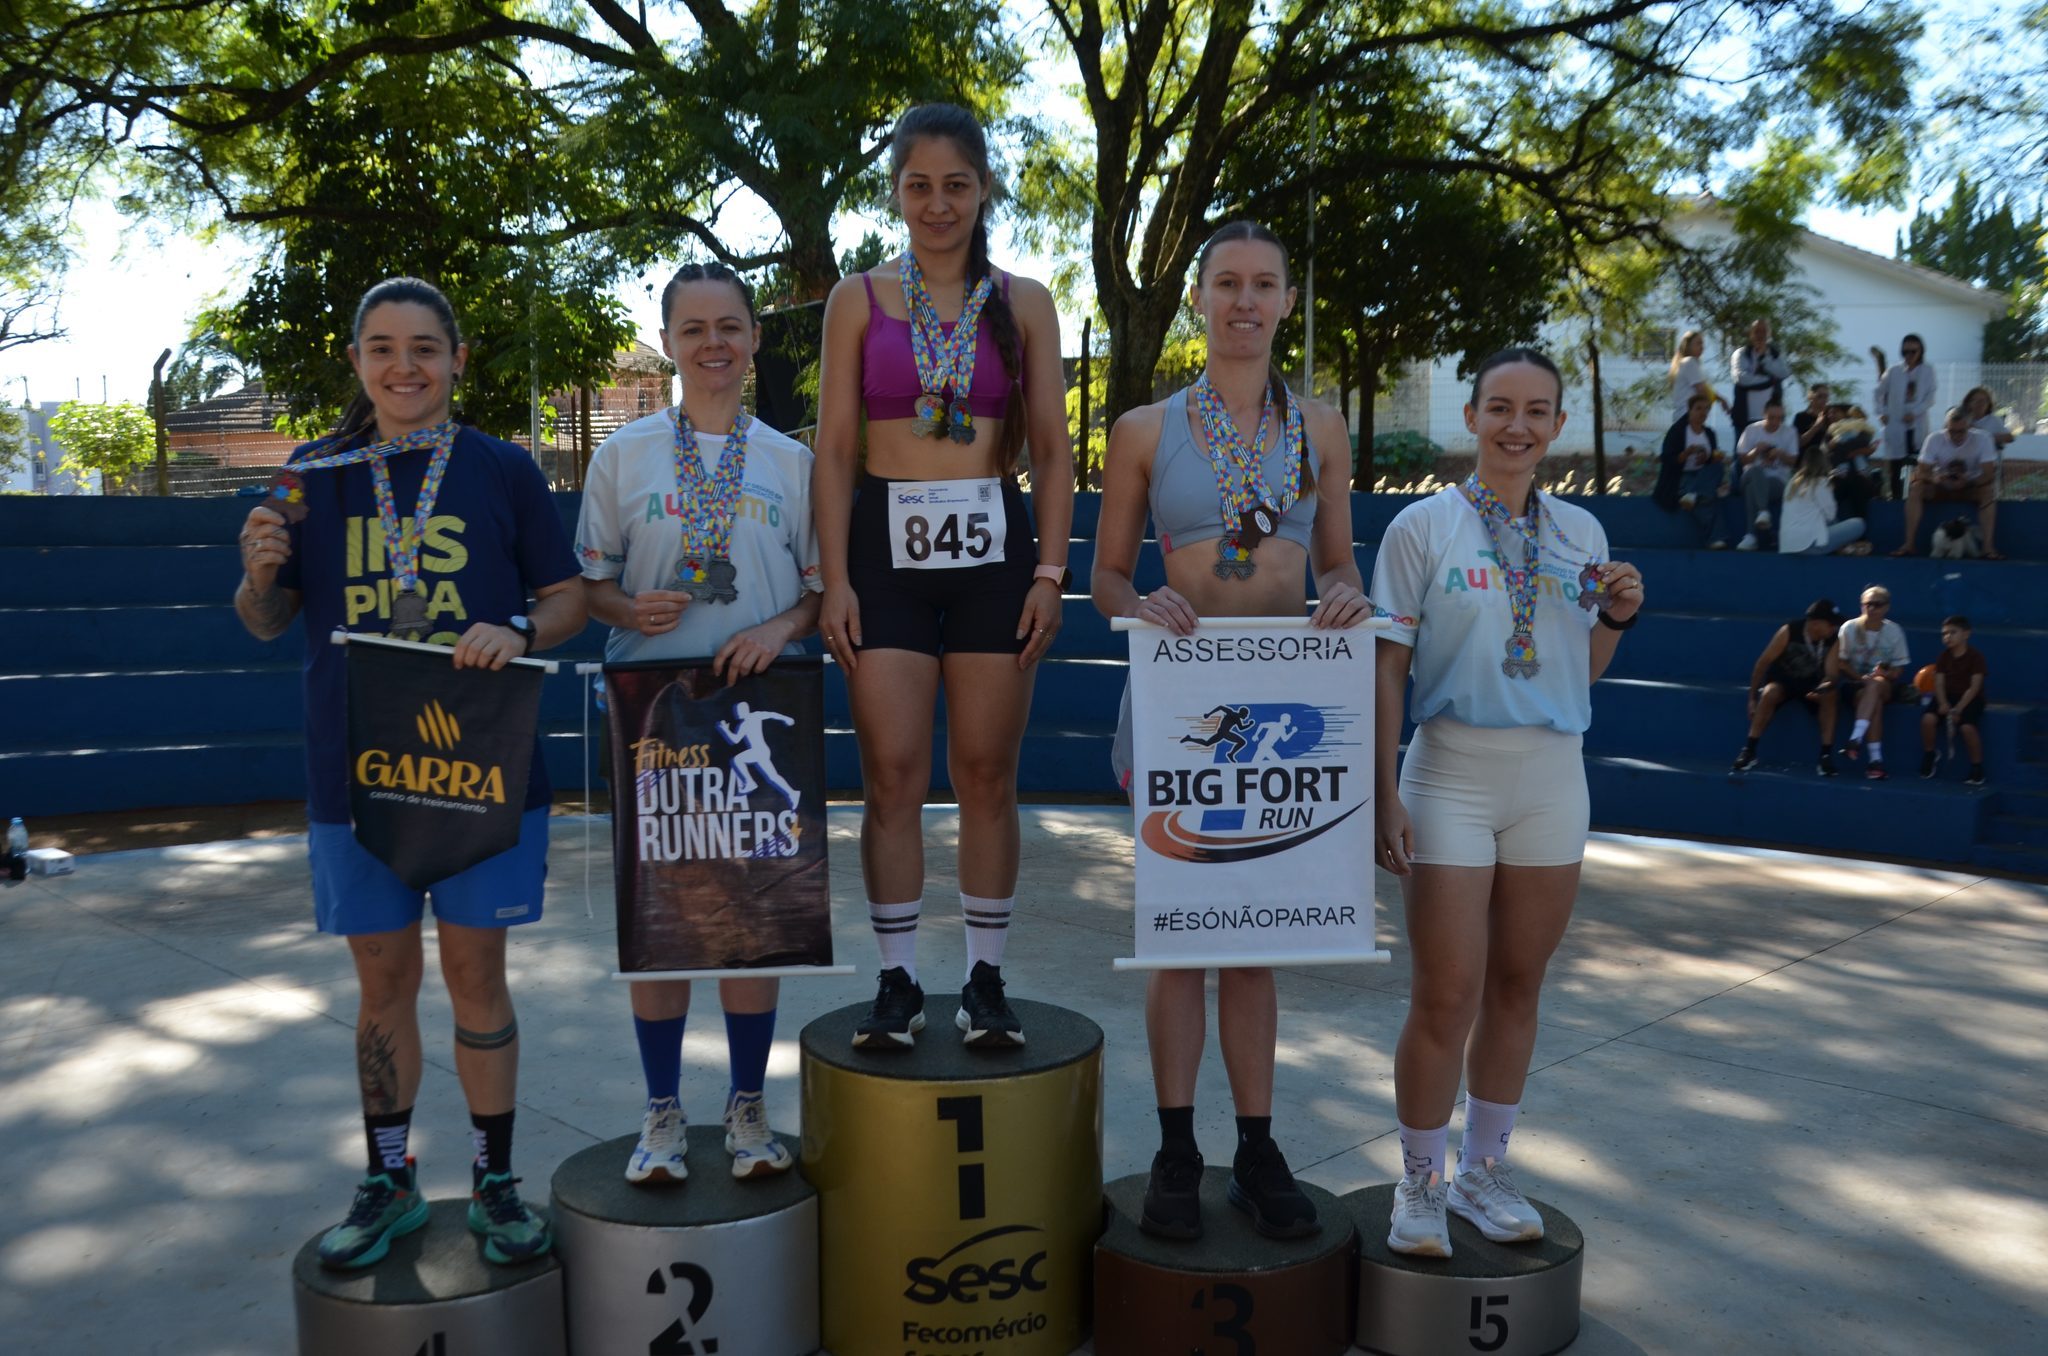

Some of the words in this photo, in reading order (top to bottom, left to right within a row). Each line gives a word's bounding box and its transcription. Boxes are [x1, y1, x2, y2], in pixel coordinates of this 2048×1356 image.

[645, 491, 780, 528] Aumo
[345, 515, 469, 578] INS
[904, 512, 993, 562] 845
[1153, 636, 1353, 663] ASSESSORIA
[356, 749, 506, 804] GARRA
[629, 737, 711, 777] Fitness
[368, 790, 405, 802] centro
[406, 793, 421, 805] de
[422, 797, 488, 814] treinamento
[637, 767, 750, 815] DUTRA
[1148, 768, 1223, 807] BIG
[1236, 765, 1348, 805] FORT
[638, 810, 799, 862] RUNNERS
[1258, 807, 1314, 830] RUN
[1153, 904, 1356, 932] #ÉSÓNÃOPARAR
[937, 1095, 986, 1221] 1
[903, 1245, 1048, 1305] Sesc
[646, 1261, 719, 1356] 2
[903, 1311, 1048, 1344] Fecomércio
[1191, 1283, 1256, 1356] 3
[1468, 1294, 1509, 1353] 5
